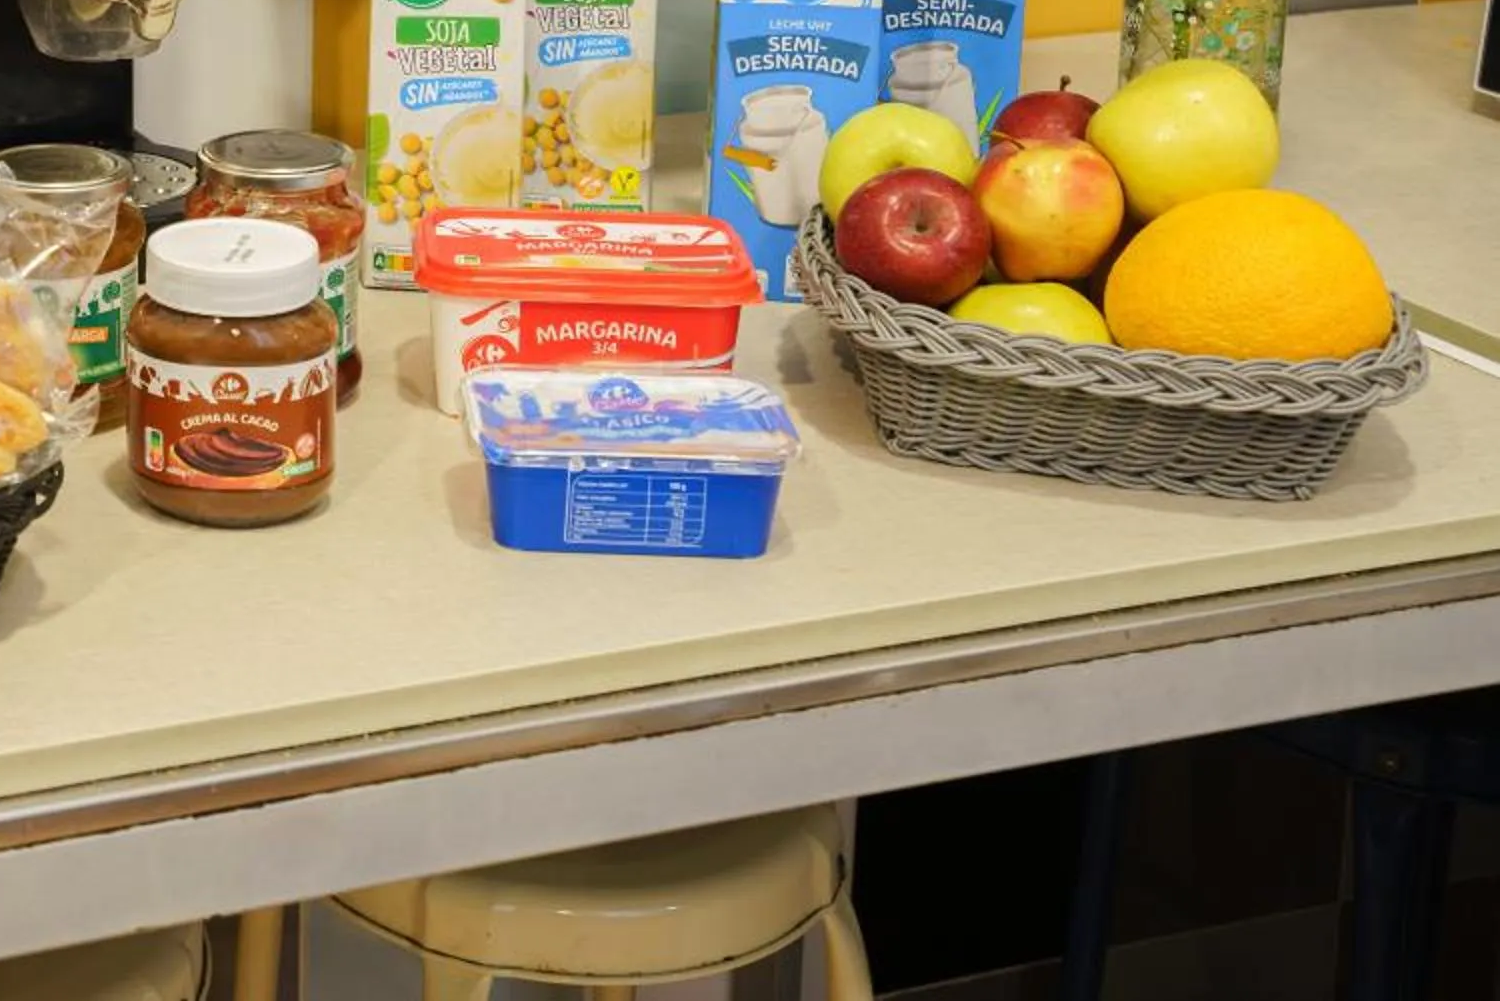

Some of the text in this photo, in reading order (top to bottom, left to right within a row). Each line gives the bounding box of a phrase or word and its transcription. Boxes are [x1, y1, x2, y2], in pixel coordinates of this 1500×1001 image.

[425, 19, 470, 45] SOJA
[768, 19, 834, 31] LECHE UHT
[885, 11, 1005, 36] DESNATADA
[543, 38, 577, 64] SIN
[768, 35, 828, 53] SEMI-
[734, 53, 860, 78] DESNATADA
[404, 80, 440, 105] SIN
[515, 241, 653, 256] MARGARINA
[535, 320, 678, 348] MARGARINA
[591, 342, 618, 355] 3/4
[180, 412, 280, 432] CREMA AL CACAO
[580, 413, 670, 429] ASICO
